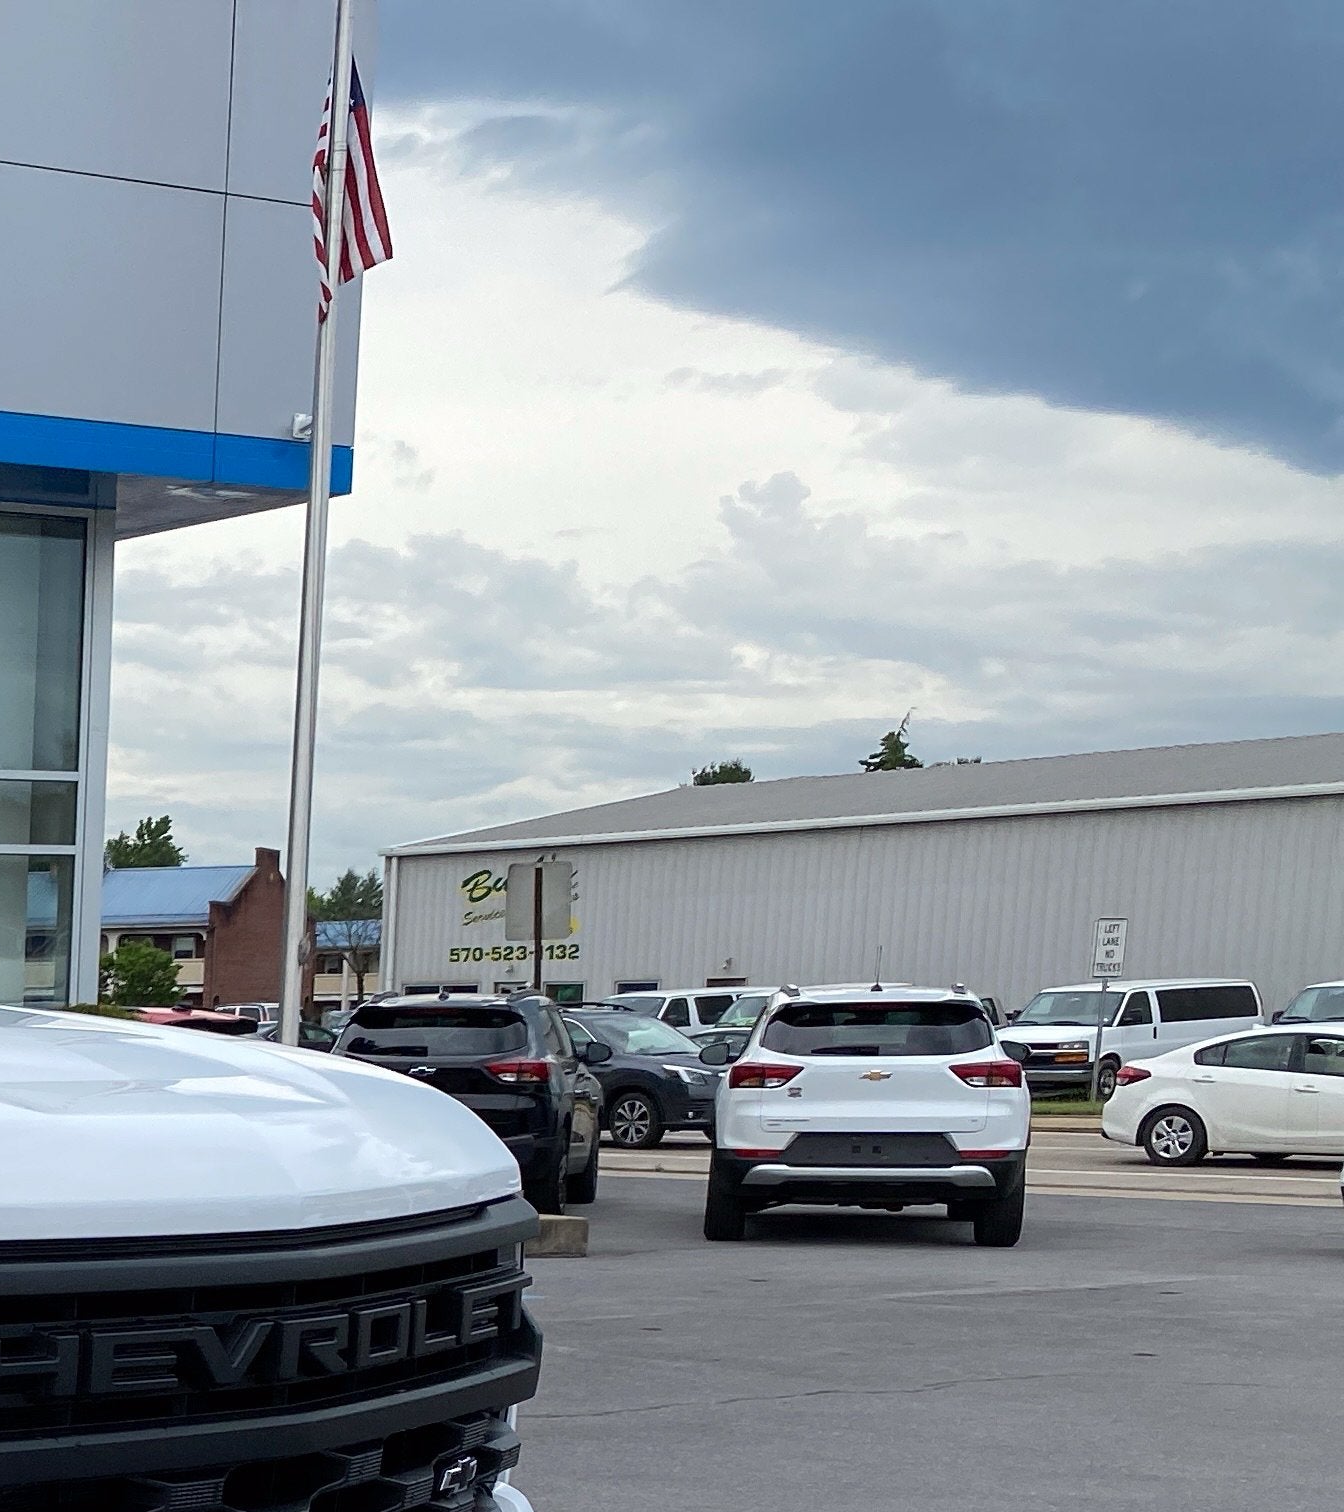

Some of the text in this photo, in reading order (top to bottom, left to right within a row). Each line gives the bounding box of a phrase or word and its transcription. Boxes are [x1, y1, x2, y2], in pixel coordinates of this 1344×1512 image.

[1104, 924, 1120, 933] LEFT
[1102, 937, 1120, 946] LANE
[449, 943, 580, 963] 570-523-132
[1105, 950, 1115, 958] NO
